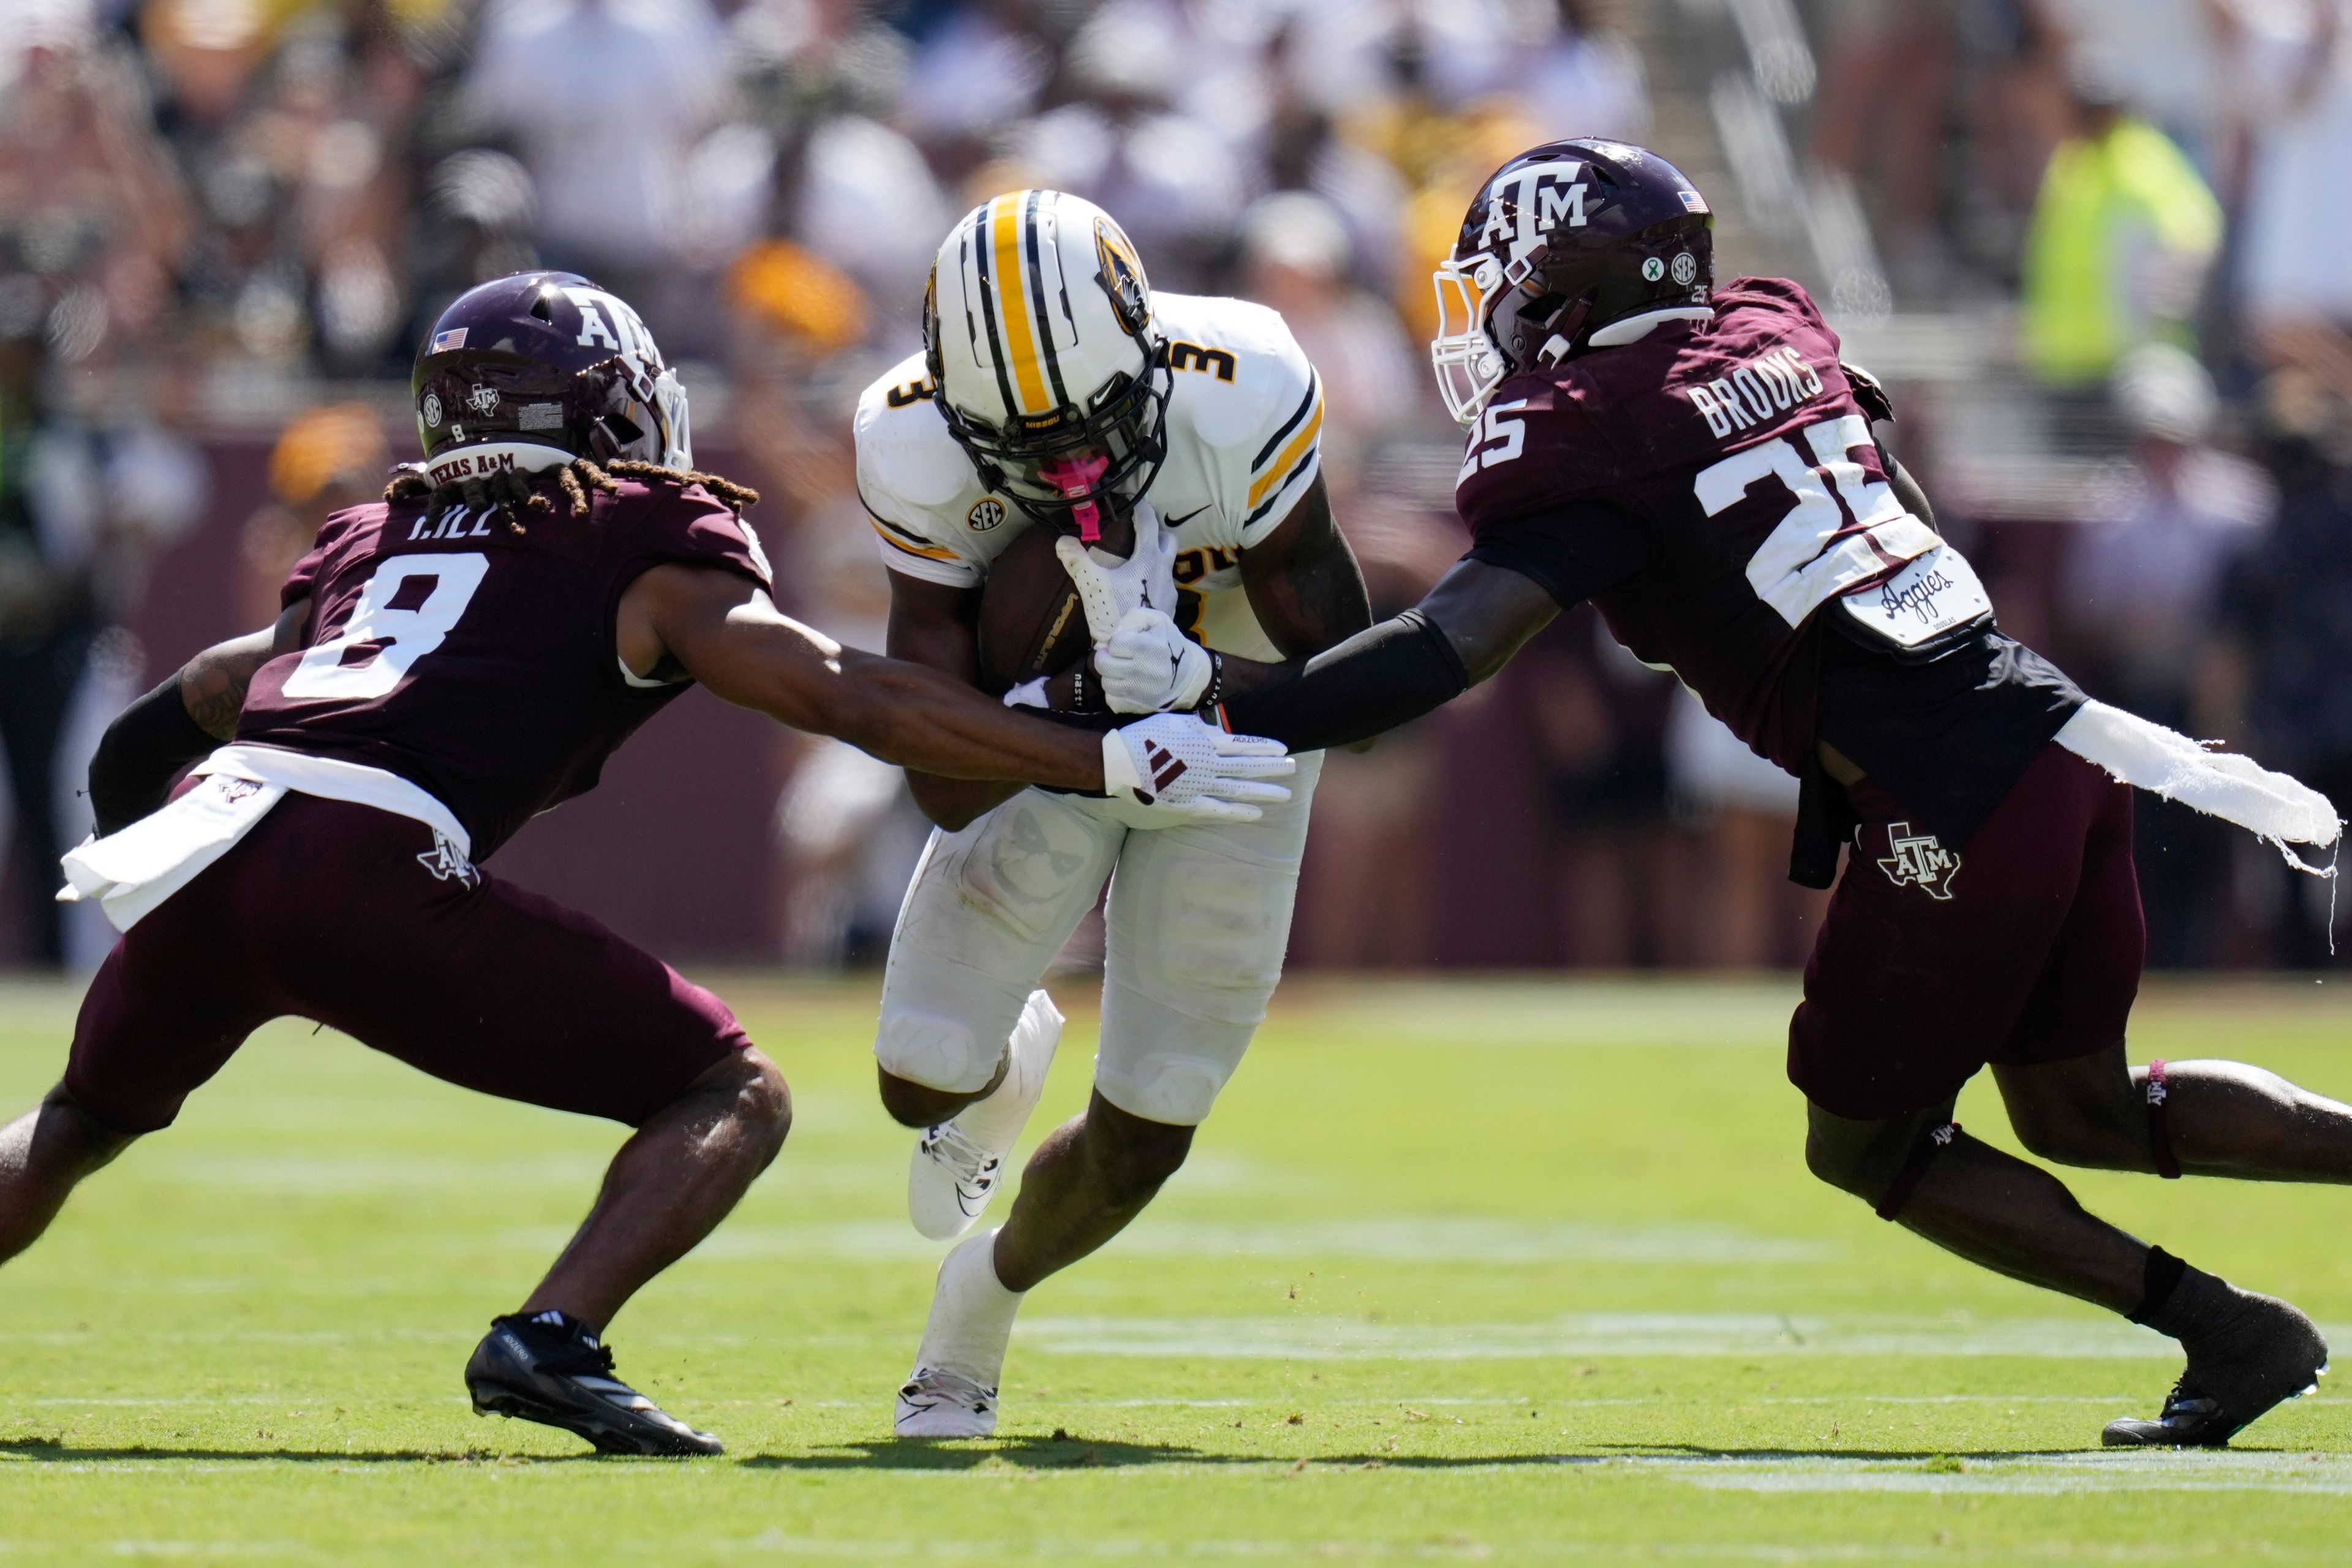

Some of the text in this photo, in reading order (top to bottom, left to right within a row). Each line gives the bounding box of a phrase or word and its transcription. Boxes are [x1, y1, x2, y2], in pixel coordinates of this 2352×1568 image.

[1674, 255, 1694, 282] SEC
[1691, 285, 1708, 303] 25
[1170, 340, 1238, 385] 3
[1686, 345, 1824, 439] BROOKS
[426, 397, 440, 425] SEC
[451, 424, 466, 442] 8
[1456, 399, 1528, 490] 25
[430, 453, 514, 486] TEXAS A&M
[970, 502, 1002, 530] SEC
[1694, 414, 1943, 630] 25
[1881, 570, 1954, 624] Aggies
[281, 552, 490, 698] 8
[1933, 616, 1957, 631] DOUGLAS
[502, 1334, 528, 1360] ADIZERO
